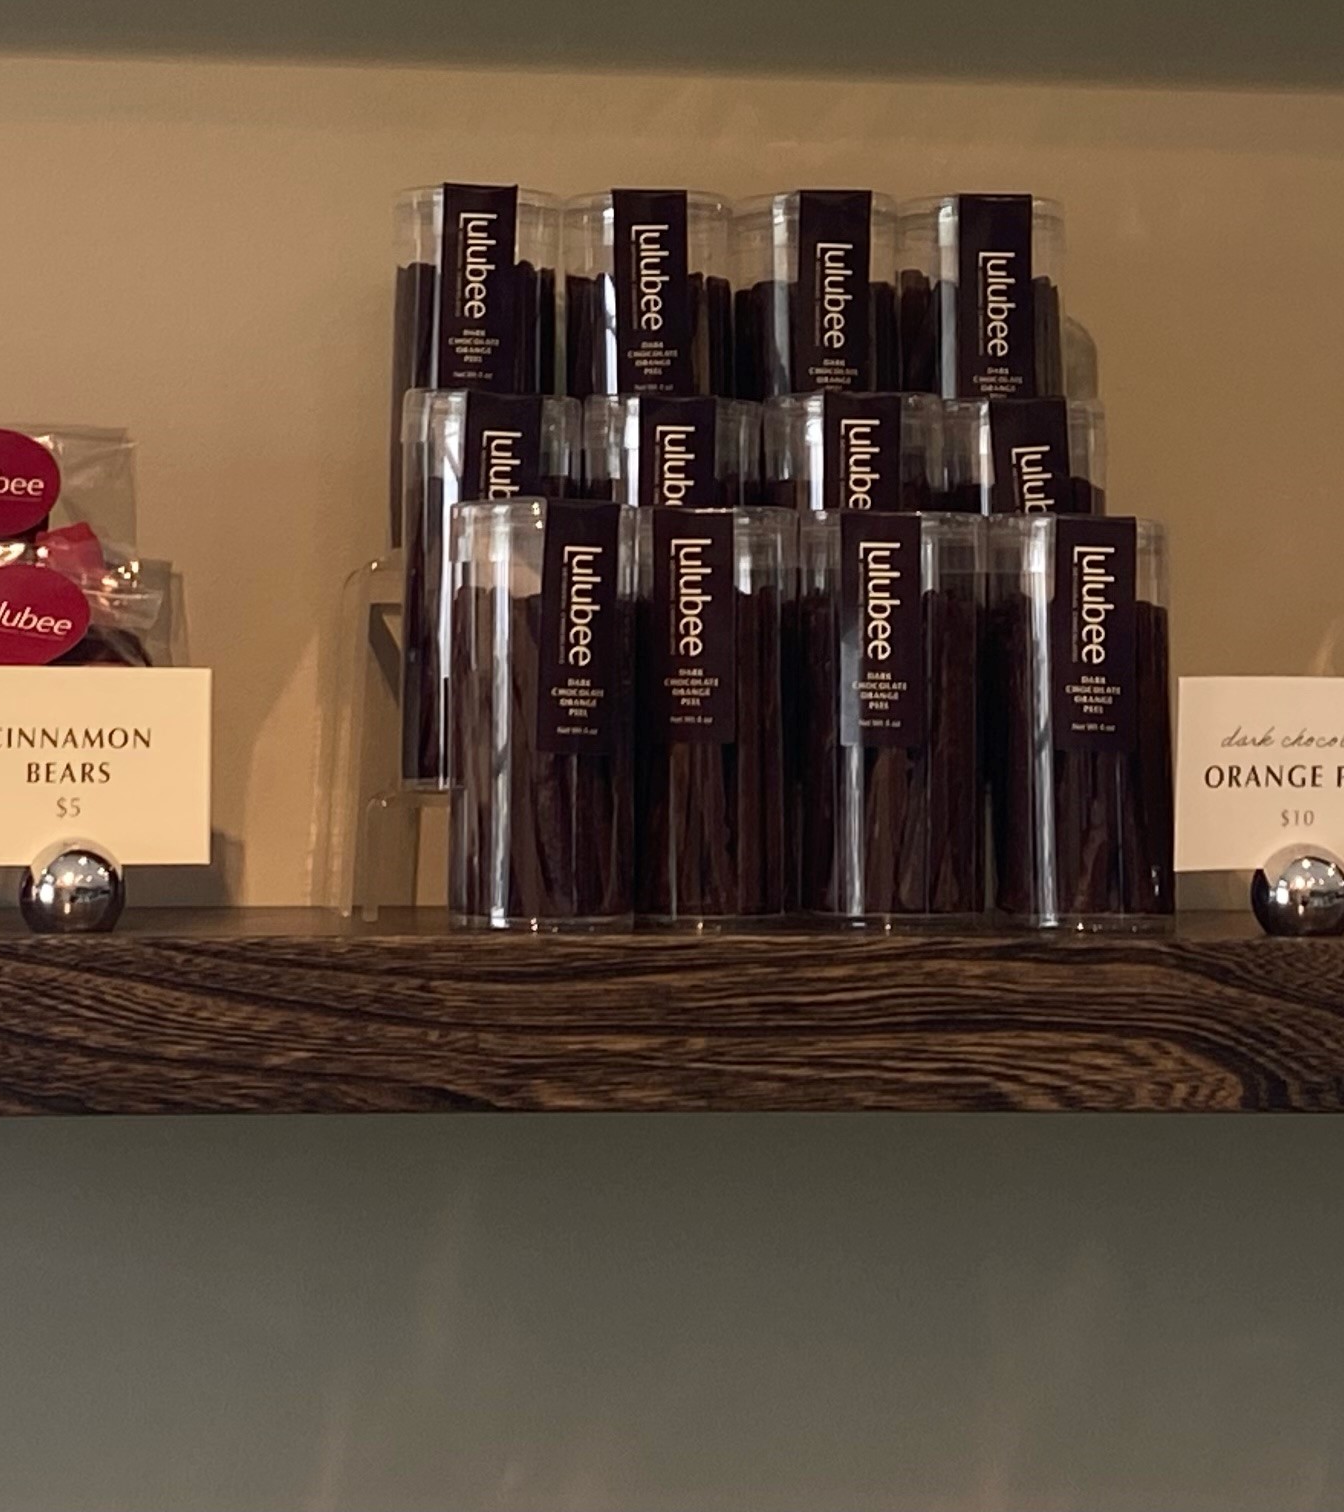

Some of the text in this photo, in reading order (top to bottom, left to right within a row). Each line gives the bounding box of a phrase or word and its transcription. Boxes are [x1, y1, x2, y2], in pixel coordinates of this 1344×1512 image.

[459, 212, 498, 319] Lulubee
[631, 224, 670, 331] Lulubee
[816, 243, 853, 349] Lulubee
[979, 251, 1016, 357] Lulubee
[563, 545, 603, 667] Lulubee
[671, 538, 712, 657] Lulubee
[859, 542, 901, 661] Lulubee
[1073, 545, 1115, 664] Lulubee
[26, 762, 111, 784] BEARS
[1204, 764, 1324, 789] ORANGE
[1221, 725, 1275, 748] dark
[56, 796, 81, 818] $5
[1281, 809, 1315, 828] $10
